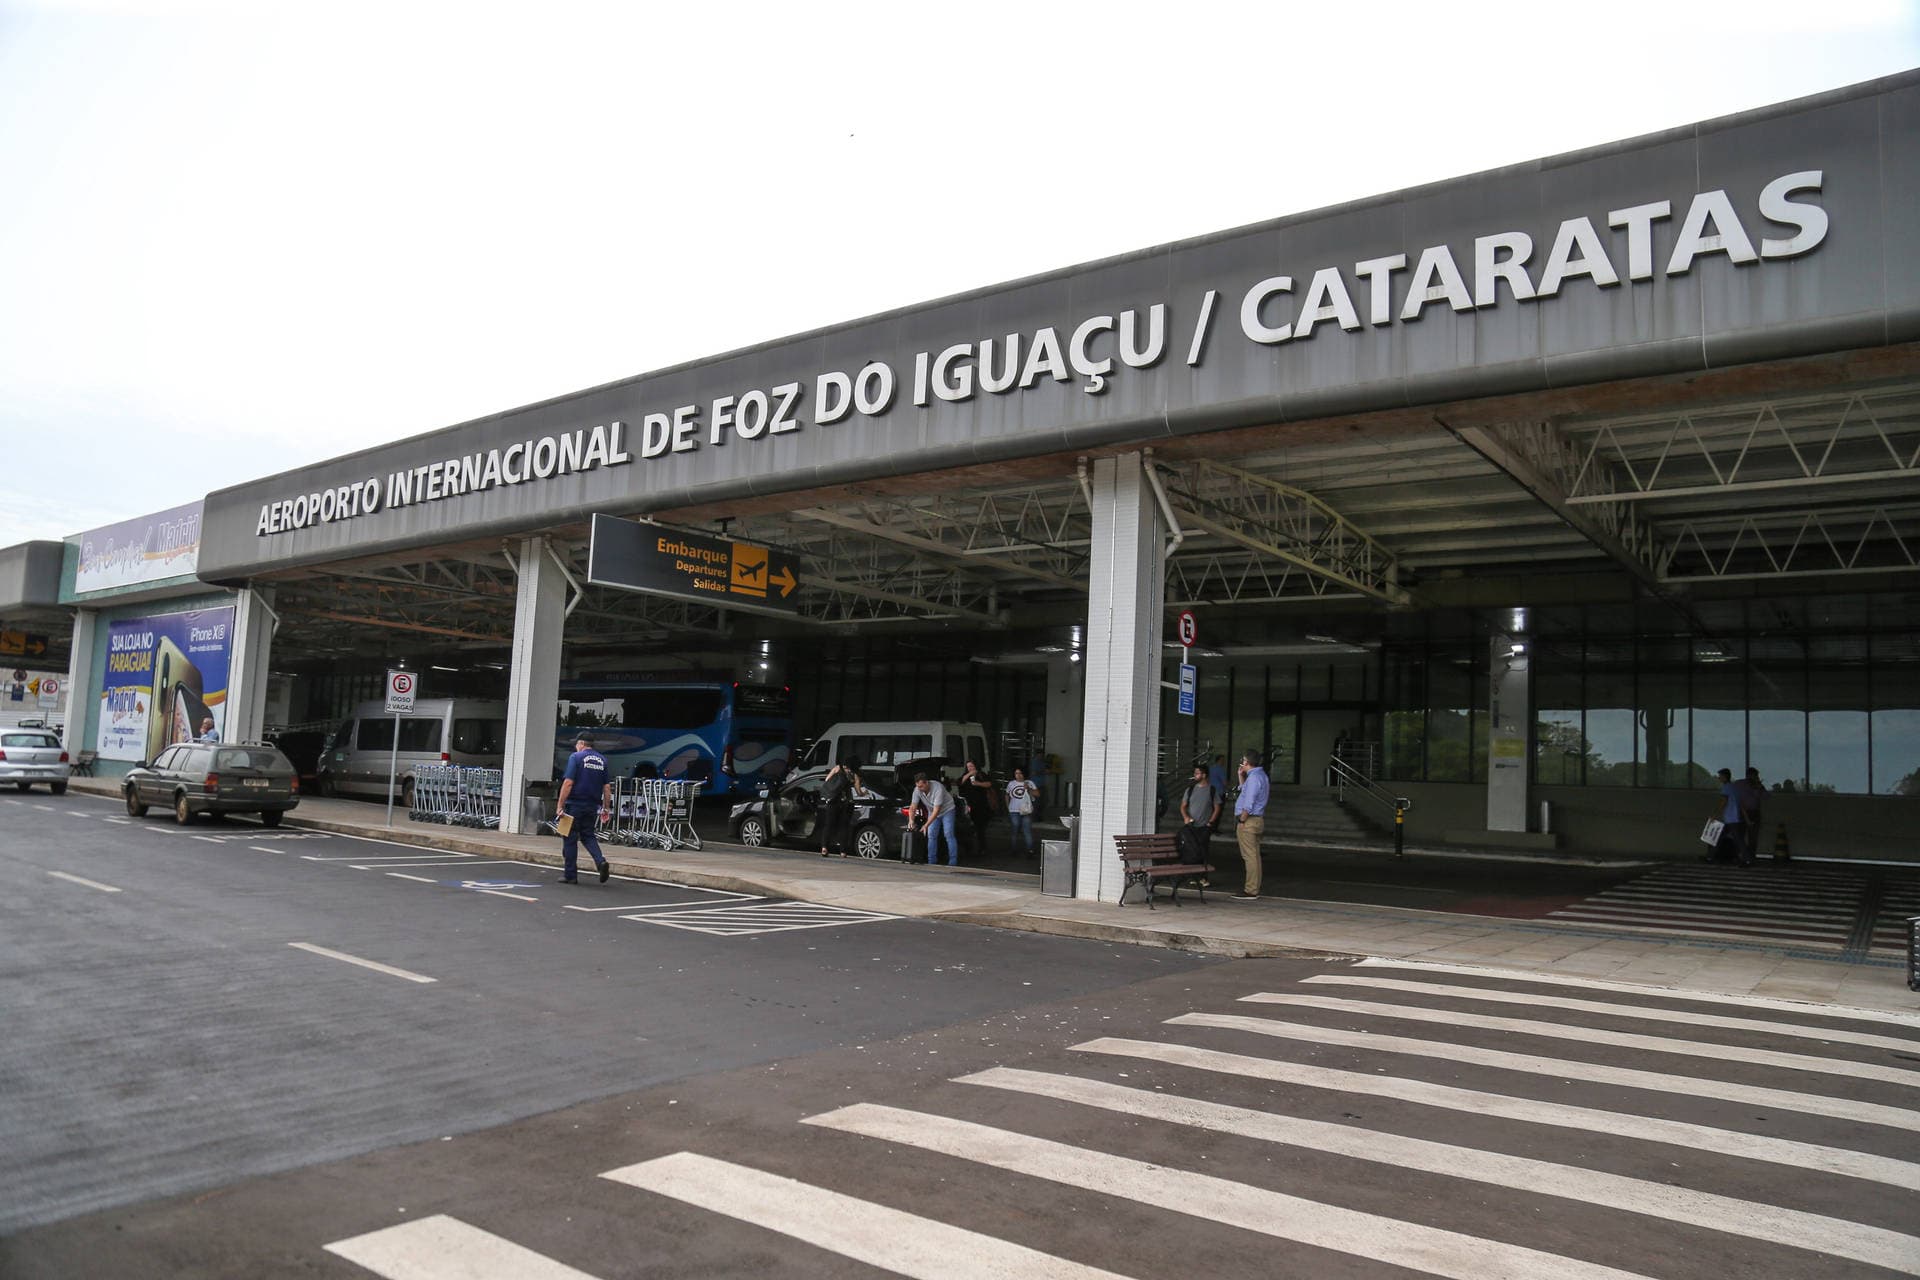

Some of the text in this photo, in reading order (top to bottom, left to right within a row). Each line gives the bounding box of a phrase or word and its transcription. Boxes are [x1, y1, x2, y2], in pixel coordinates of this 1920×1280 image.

[256, 170, 1830, 537] AEROPORTO INTERNACIONAL DE FOZ DO IGUAÇU / CATARATAS
[657, 537, 728, 564] Embarque
[675, 559, 727, 578] Departures
[693, 577, 726, 592] Salidas
[111, 631, 154, 652] SUA LOJA NO
[190, 626, 213, 643] iPhone
[106, 685, 137, 713] Madrid
